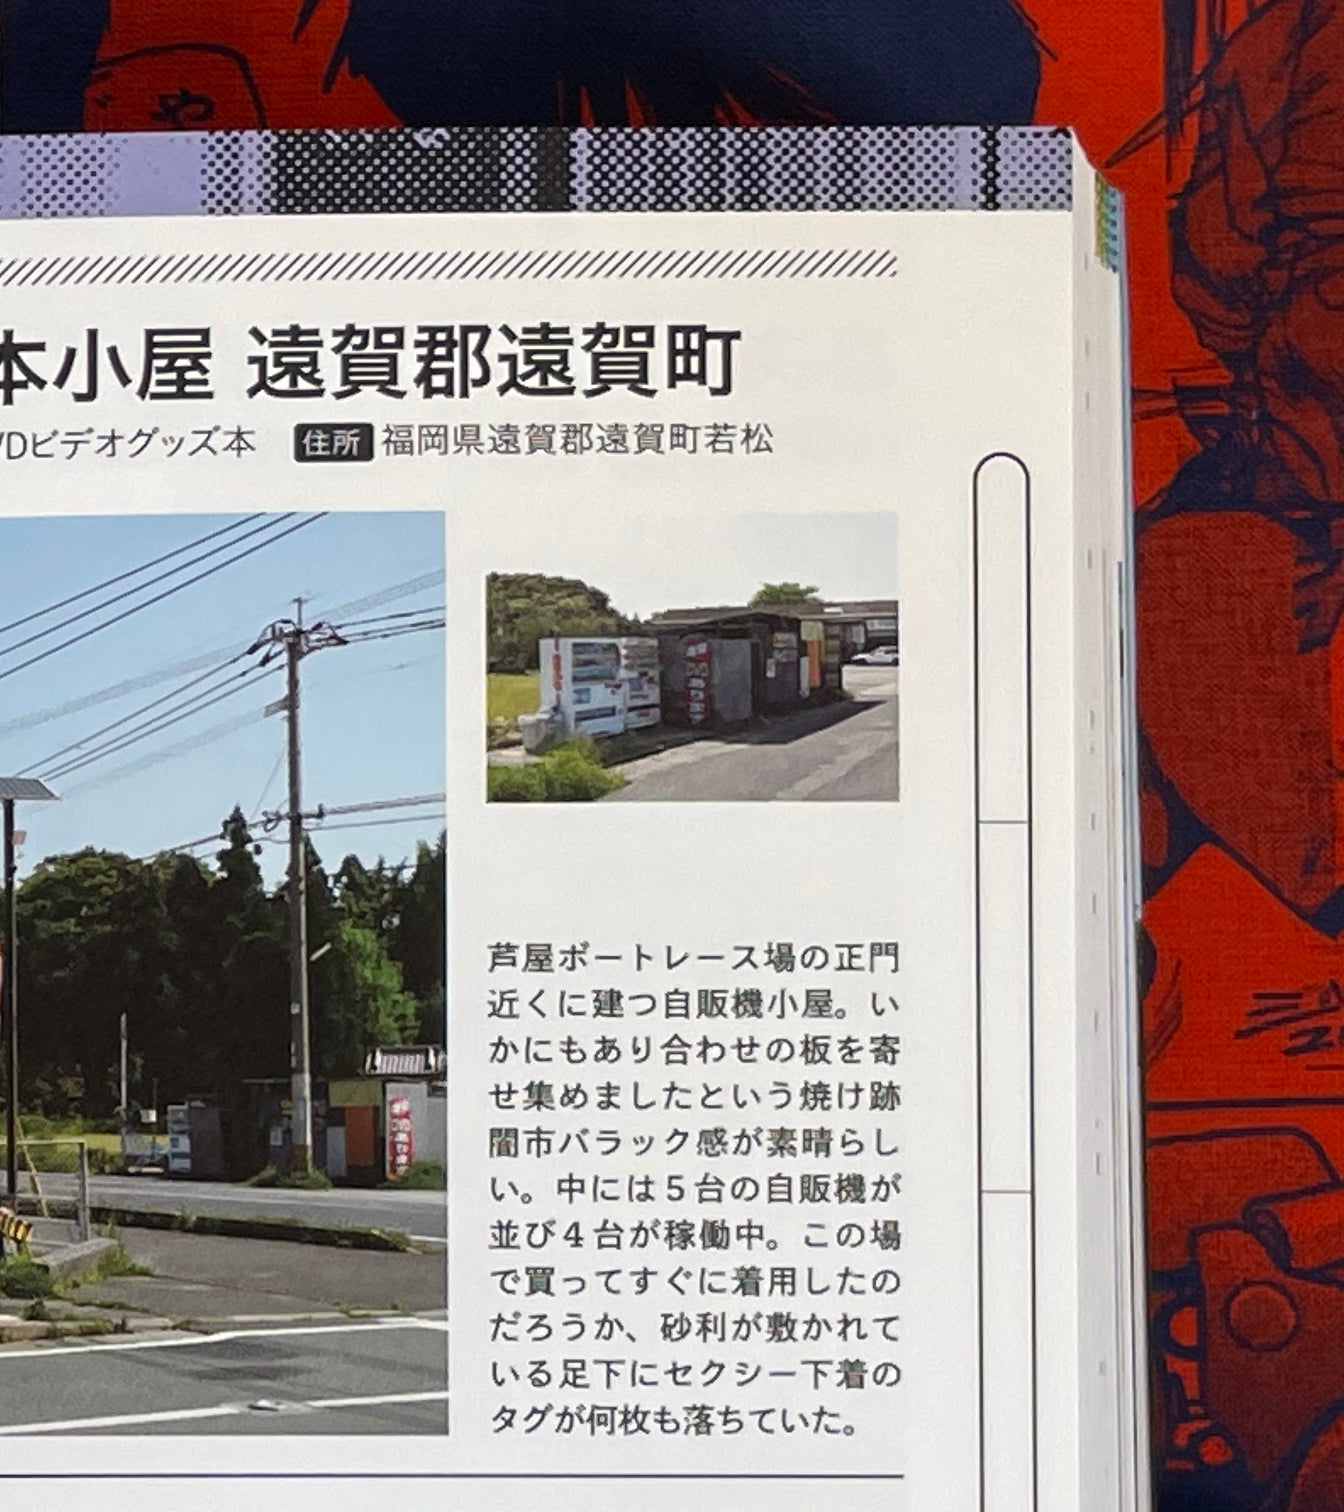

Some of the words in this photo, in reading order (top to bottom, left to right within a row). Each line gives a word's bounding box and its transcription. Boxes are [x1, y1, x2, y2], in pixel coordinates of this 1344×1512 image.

[246, 322, 741, 400] 遠賀郡遠賀町
[301, 430, 362, 457] 住所
[381, 422, 774, 457] 福岡県遠賀郡遠賀町若松
[488, 941, 901, 974] 芦屋ボートレース場の正門
[488, 988, 901, 1020] 近くに建つ自販機小屋。い
[488, 1034, 901, 1066] かにもあり合わせの板を寄
[488, 1080, 901, 1112] せ集めましたという焼け跡
[488, 1127, 901, 1158] 闇市バラック感が素晴らし
[488, 1266, 901, 1298] で買ってすぐに着用したの
[488, 1312, 901, 1343] だろうか、砂利が敷かれて
[488, 1358, 901, 1390] いる足下にセクシー下着の
[488, 1405, 856, 1436] タグが何枚も落ちていた。
